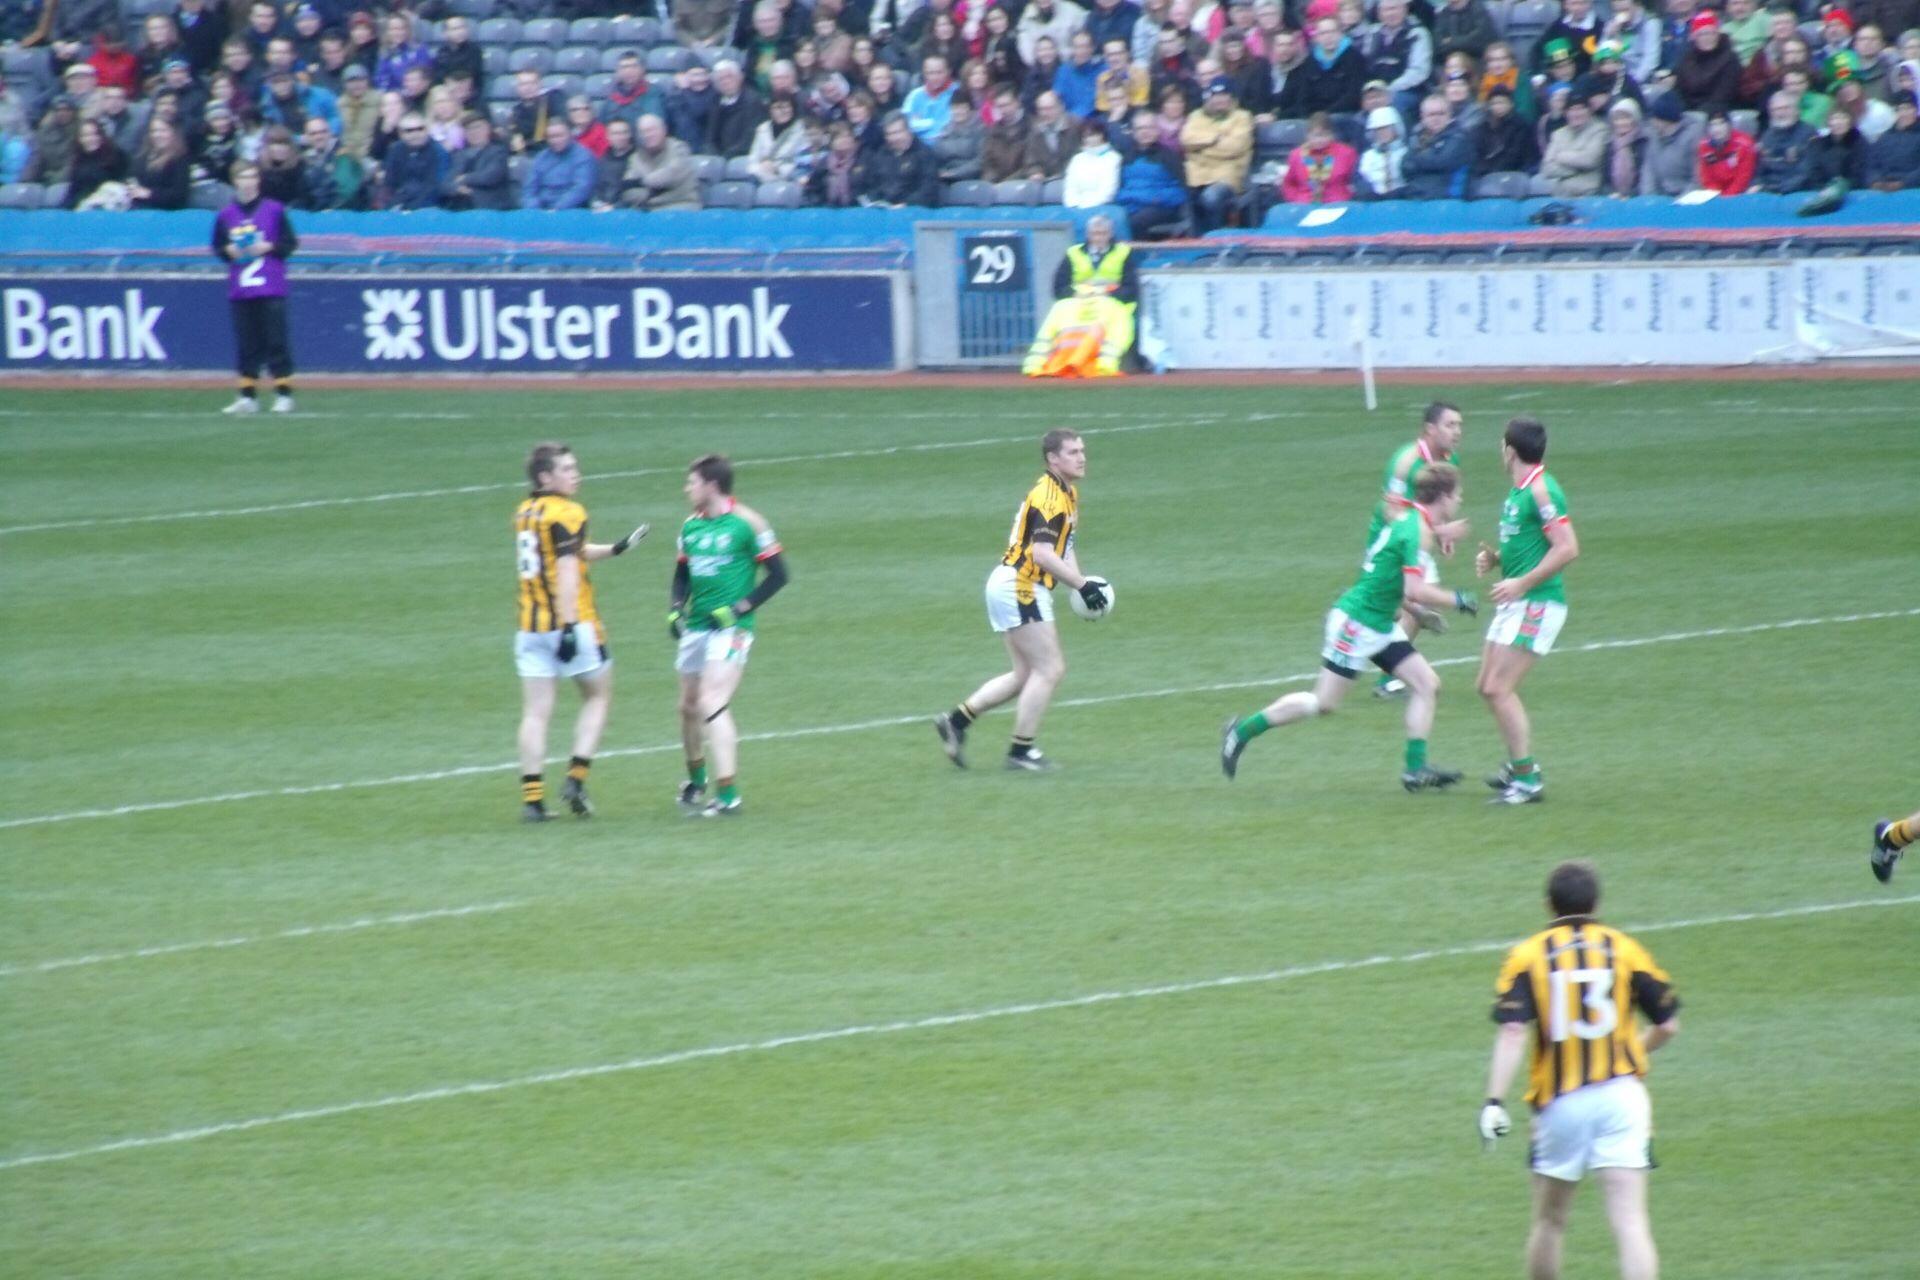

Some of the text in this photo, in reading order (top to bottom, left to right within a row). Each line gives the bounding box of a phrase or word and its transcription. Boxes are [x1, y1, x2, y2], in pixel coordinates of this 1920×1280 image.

[239, 255, 266, 287] 2
[969, 245, 1016, 284] 29
[4, 288, 167, 360] Bank
[429, 286, 794, 361] Ulster Bank
[517, 530, 540, 579] 8
[1550, 967, 1618, 1041] 13
